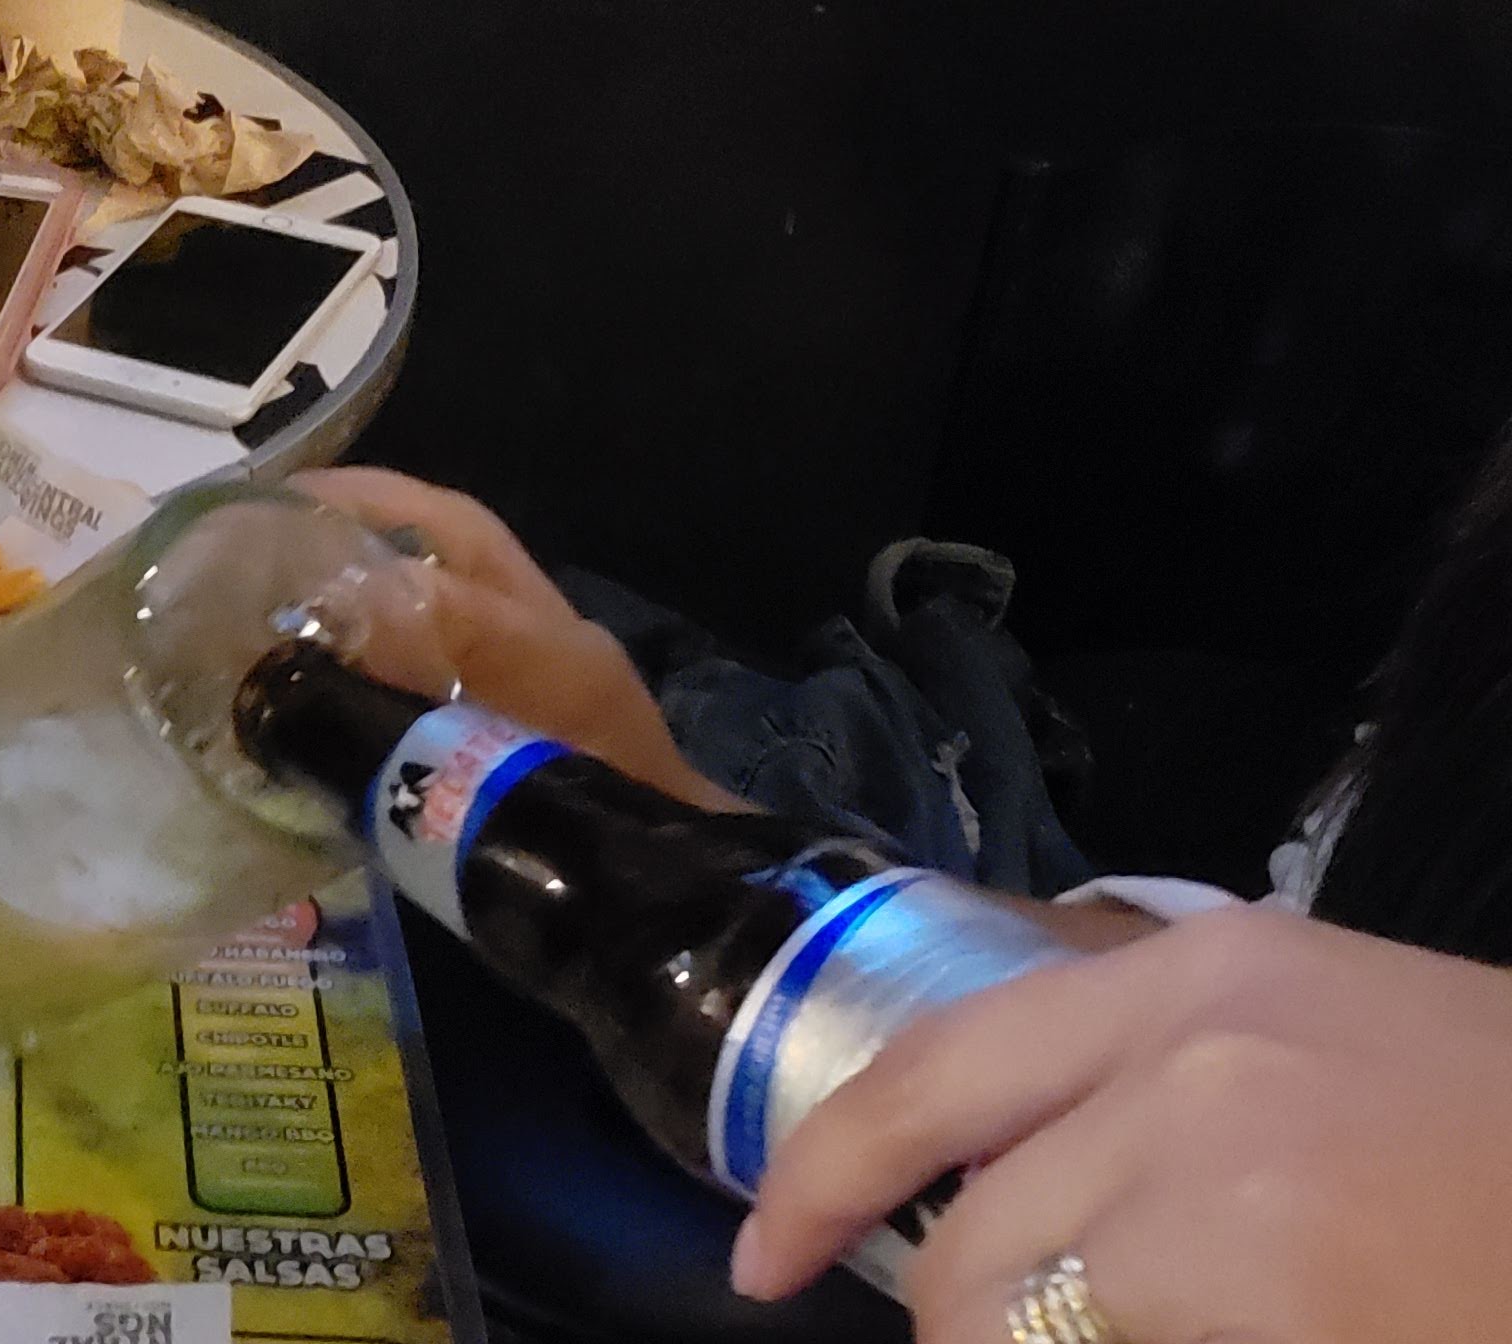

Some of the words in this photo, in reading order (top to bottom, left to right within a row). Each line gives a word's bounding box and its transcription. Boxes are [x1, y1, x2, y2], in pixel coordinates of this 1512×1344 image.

[196, 1001, 299, 1018] BUFFALO
[196, 1032, 309, 1049] CHIPOTLE
[155, 1222, 393, 1262] NUESTRAS
[192, 1255, 364, 1293] SALSAS
